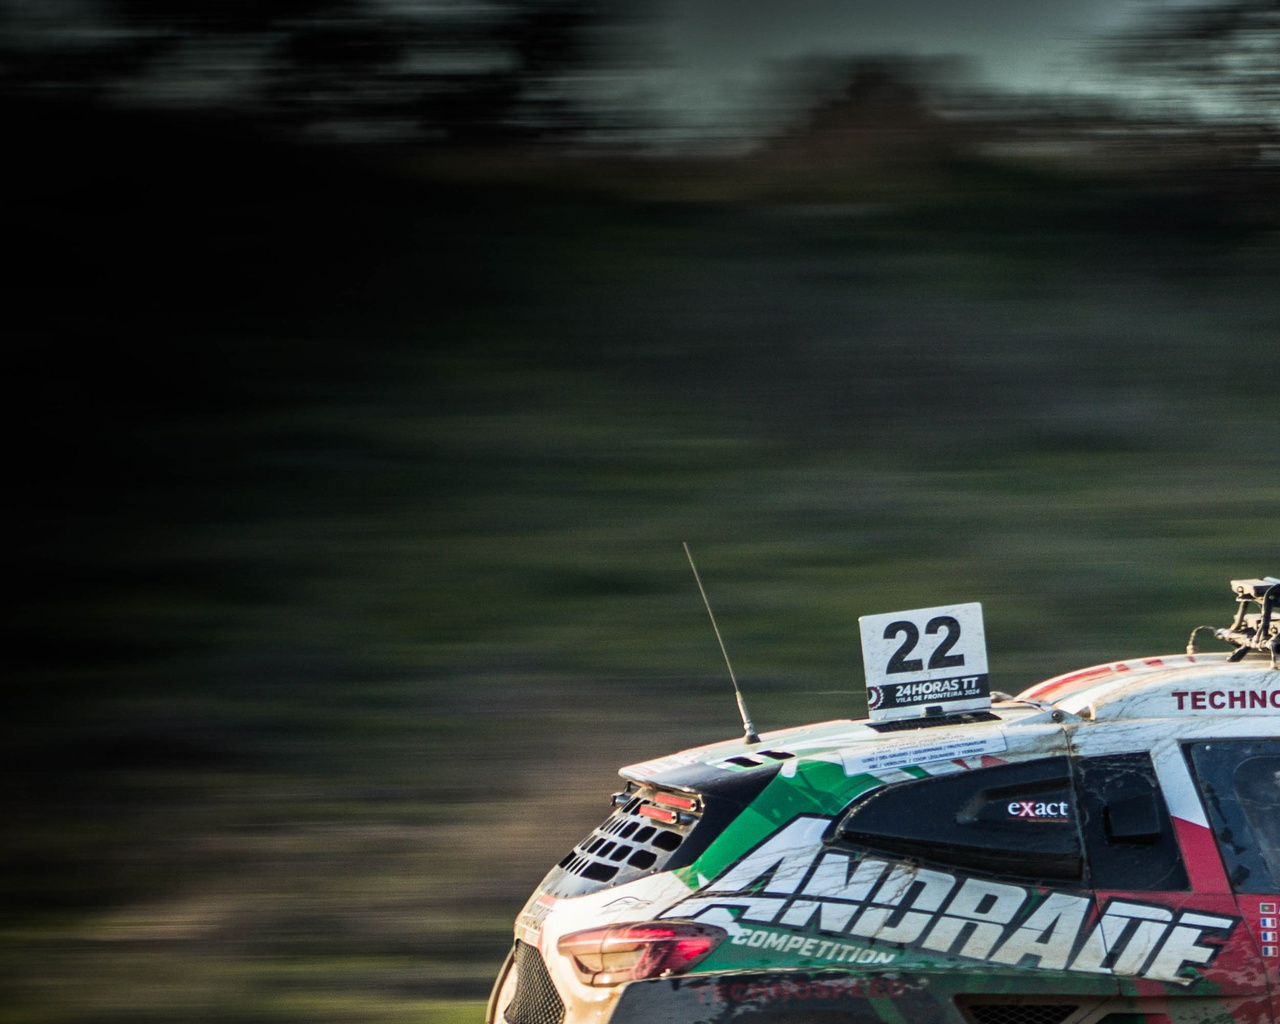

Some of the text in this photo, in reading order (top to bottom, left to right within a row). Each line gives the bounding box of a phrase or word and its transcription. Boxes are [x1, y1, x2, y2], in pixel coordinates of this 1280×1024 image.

[883, 616, 965, 675] 22
[895, 677, 979, 698] 24HORAS TT
[924, 691, 963, 700] FRONTEIRA
[964, 688, 980, 696] 2024
[657, 815, 1236, 987] ANDRADE
[731, 928, 897, 964] COMPETITION
